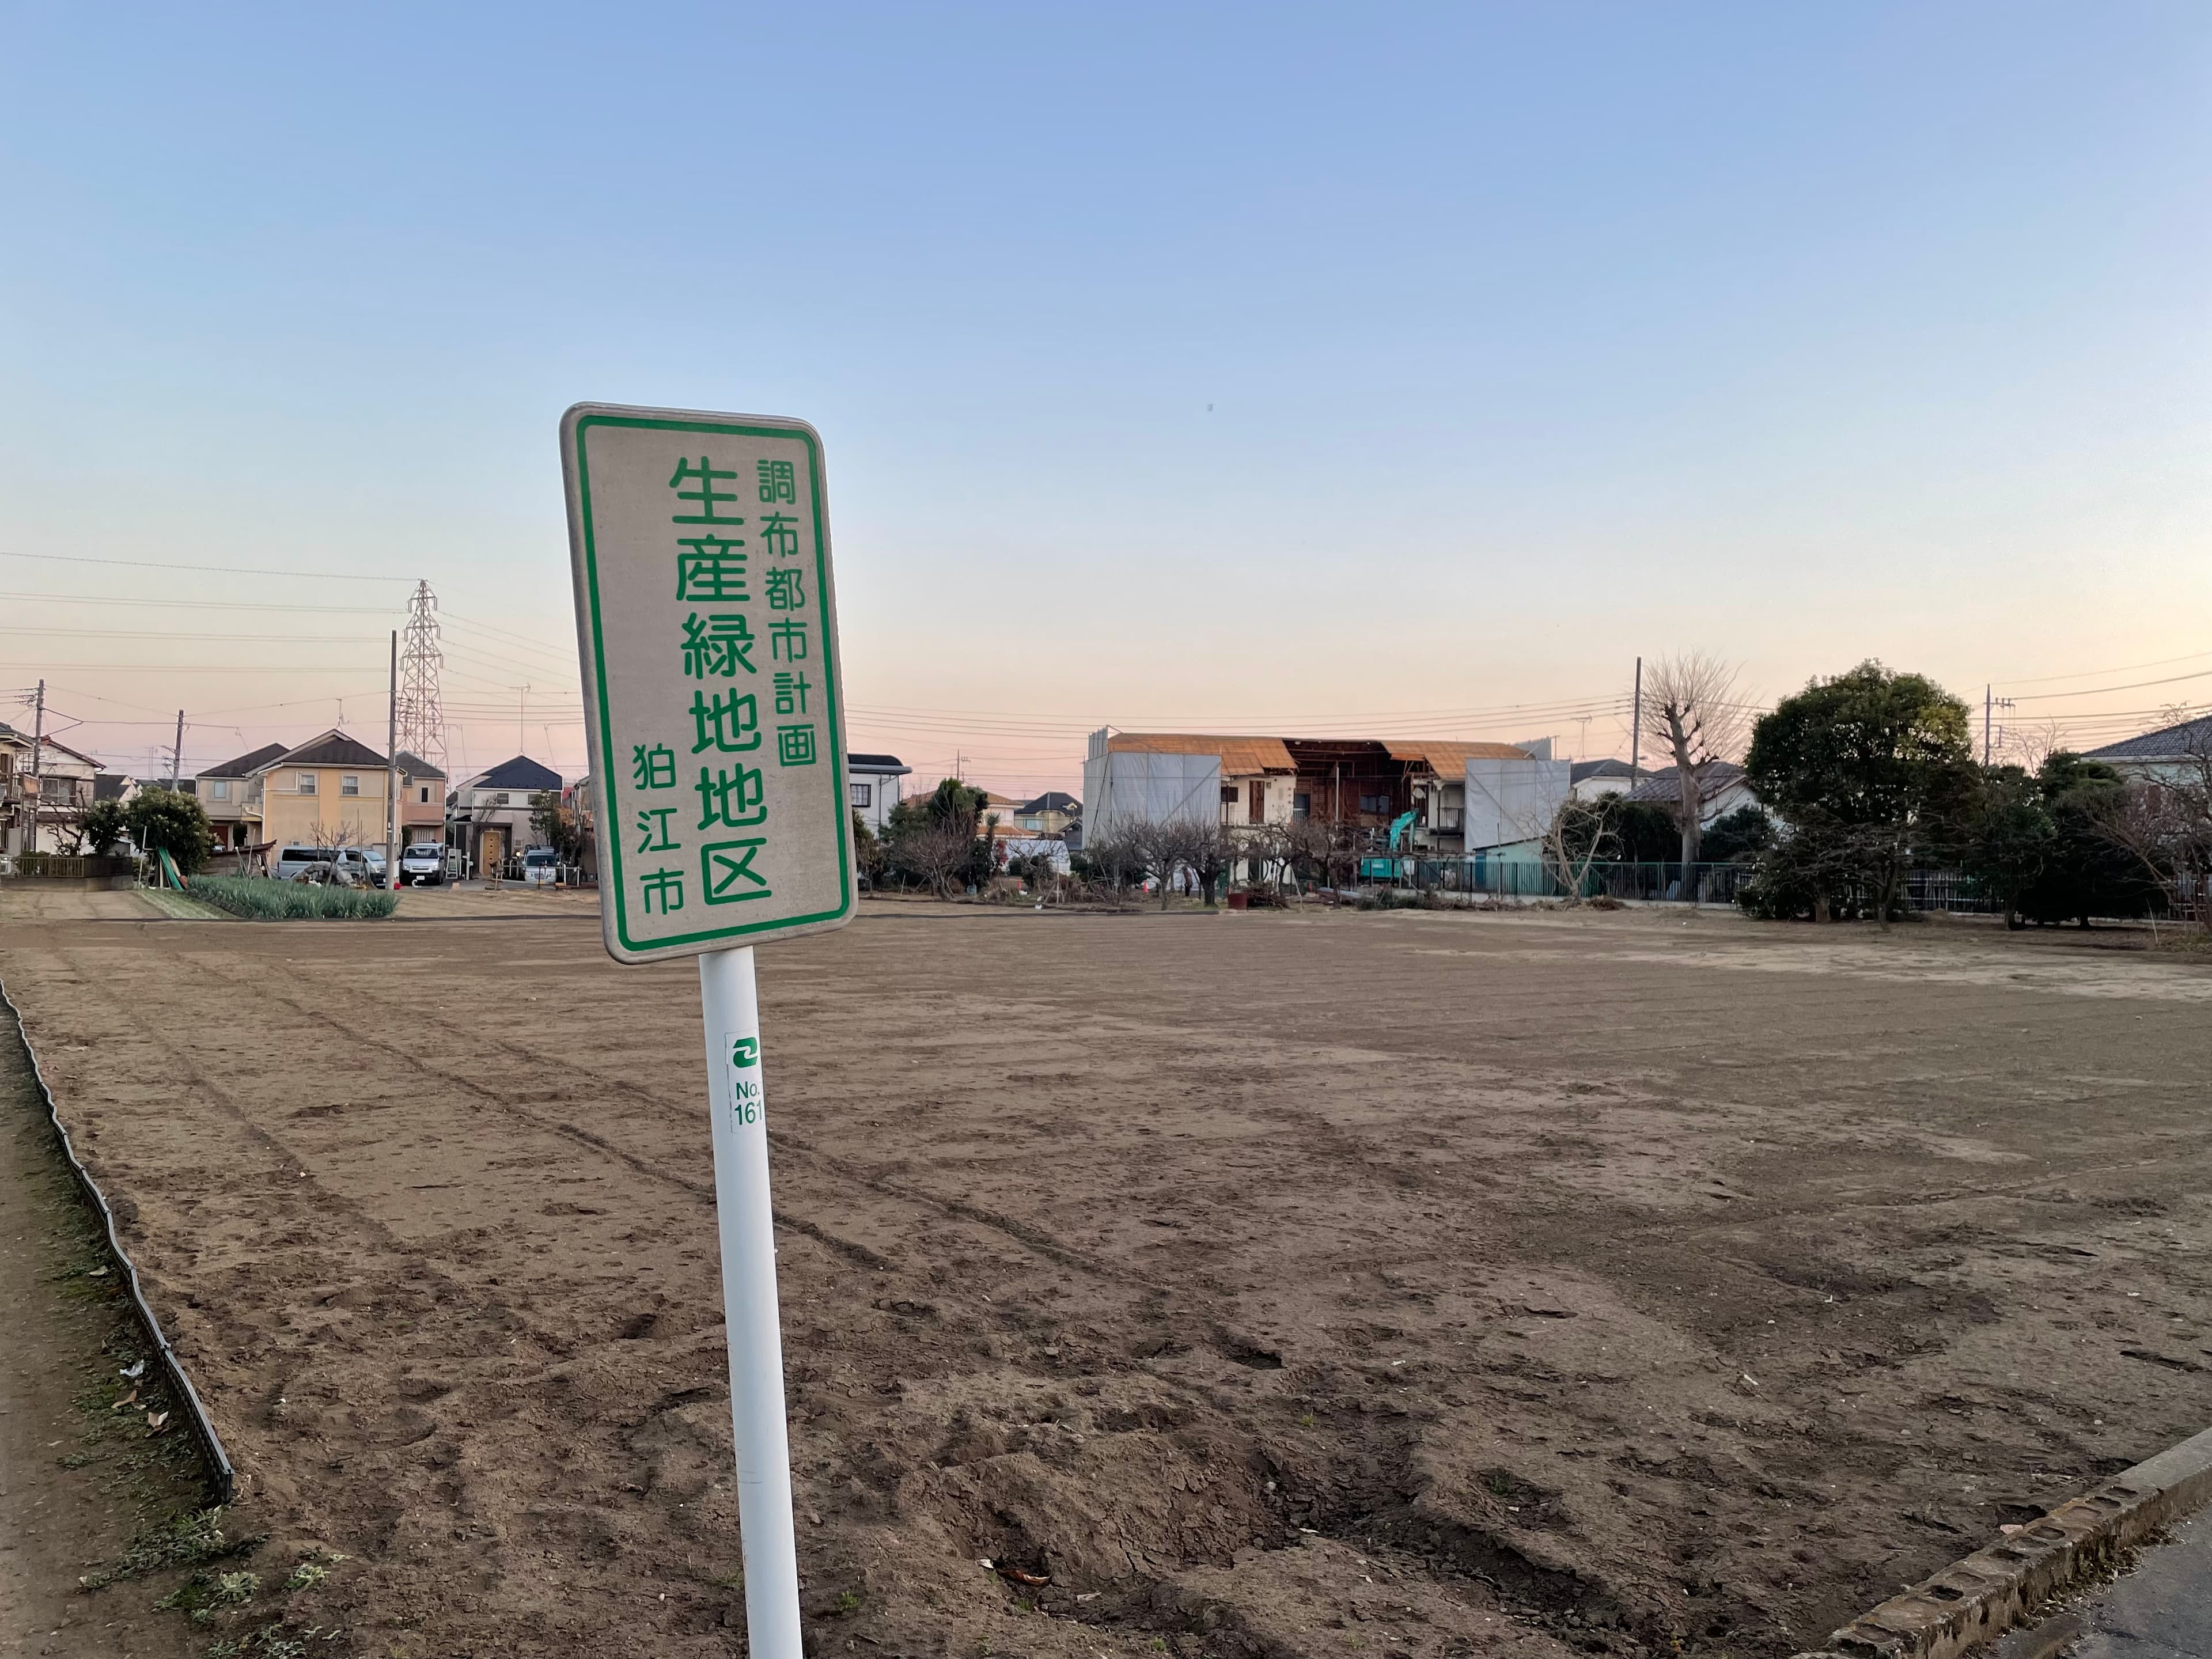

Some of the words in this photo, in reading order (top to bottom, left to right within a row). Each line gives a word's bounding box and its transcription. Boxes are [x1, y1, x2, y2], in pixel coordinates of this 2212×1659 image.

[669, 456, 773, 907] 生産緑地地区
[756, 459, 817, 768] 調布都市計画
[632, 742, 685, 916] 狛江市
[734, 1099, 763, 1126] 161
[736, 1081, 760, 1100] No.
